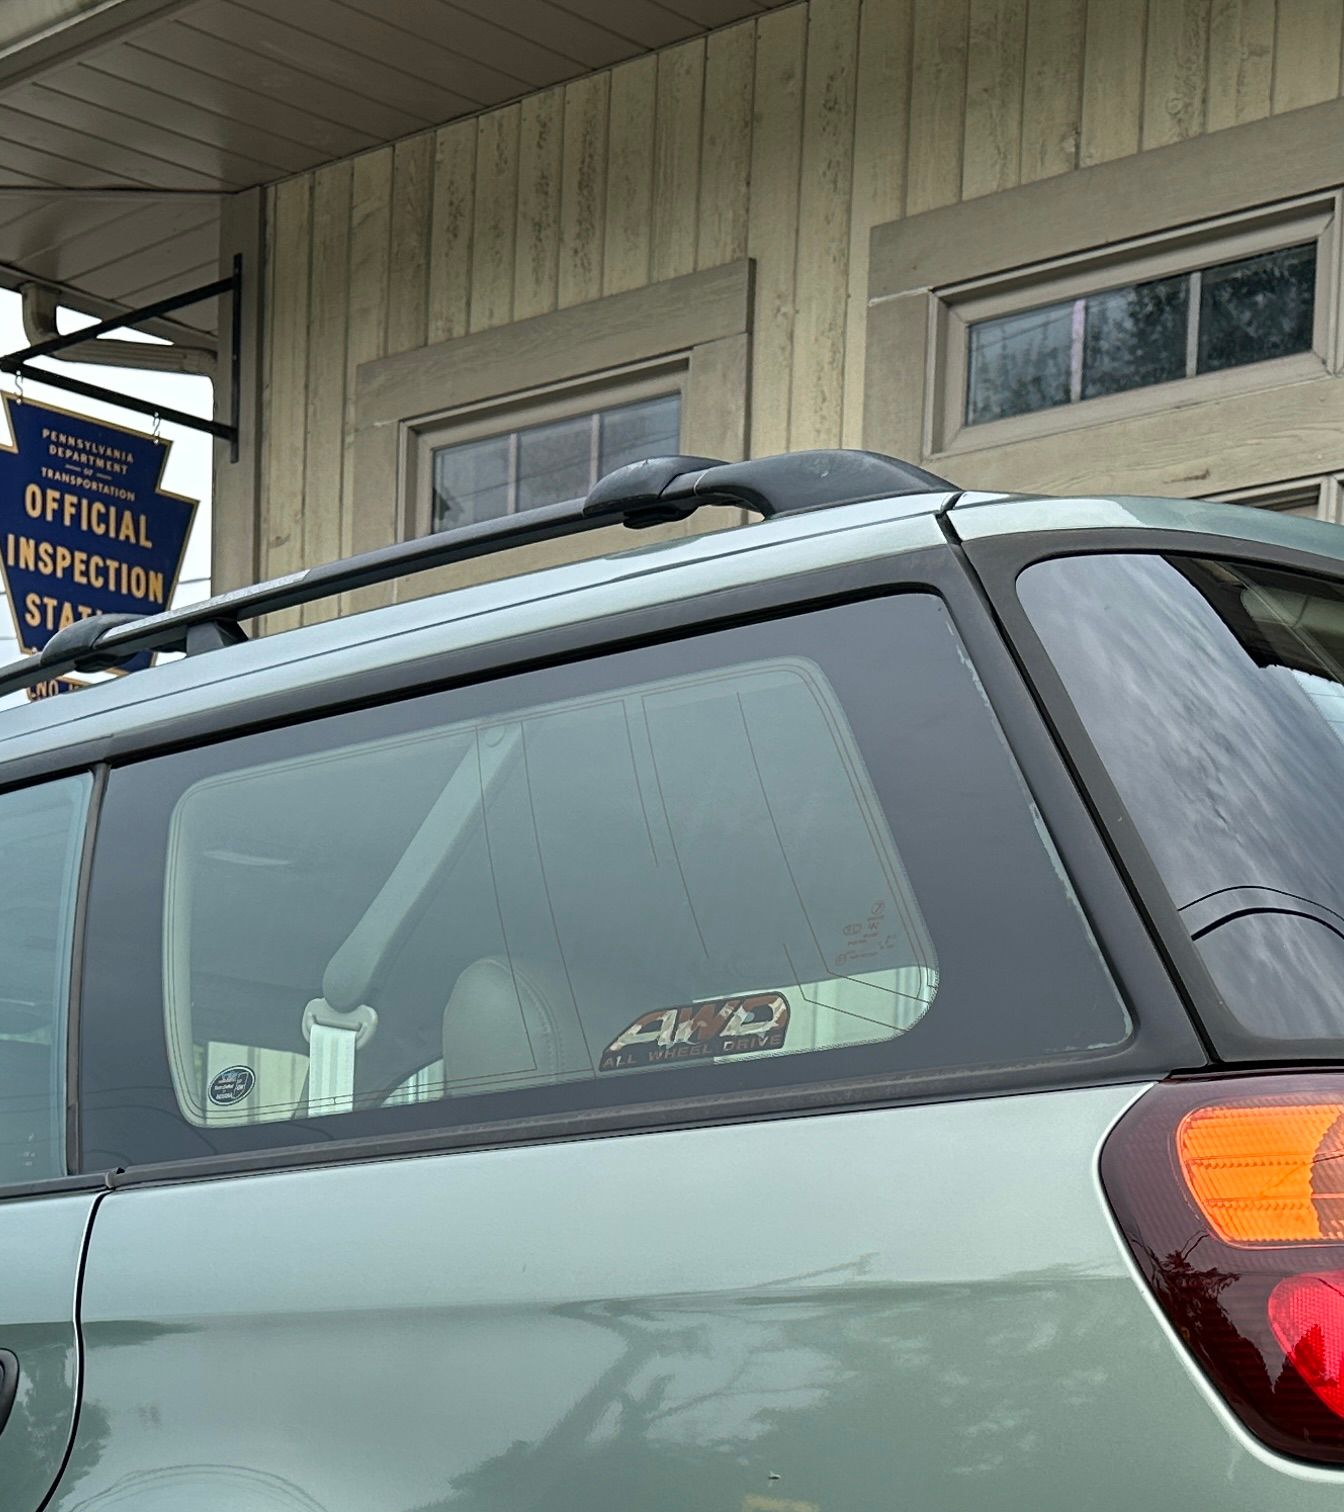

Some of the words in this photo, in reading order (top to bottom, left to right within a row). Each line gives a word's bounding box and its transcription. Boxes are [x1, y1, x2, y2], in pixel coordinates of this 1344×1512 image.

[41, 428, 134, 463] PENNSYLVANIA
[49, 444, 129, 475] DEPARTMENT
[41, 466, 136, 502] TRANSPORTATION
[25, 483, 153, 549] OFFICIAL
[7, 533, 164, 604] INSPECTION
[609, 993, 788, 1051] AWD
[603, 1055, 638, 1069] ALL
[648, 1045, 712, 1061] WHEEL
[722, 1034, 783, 1051] DRIVE
